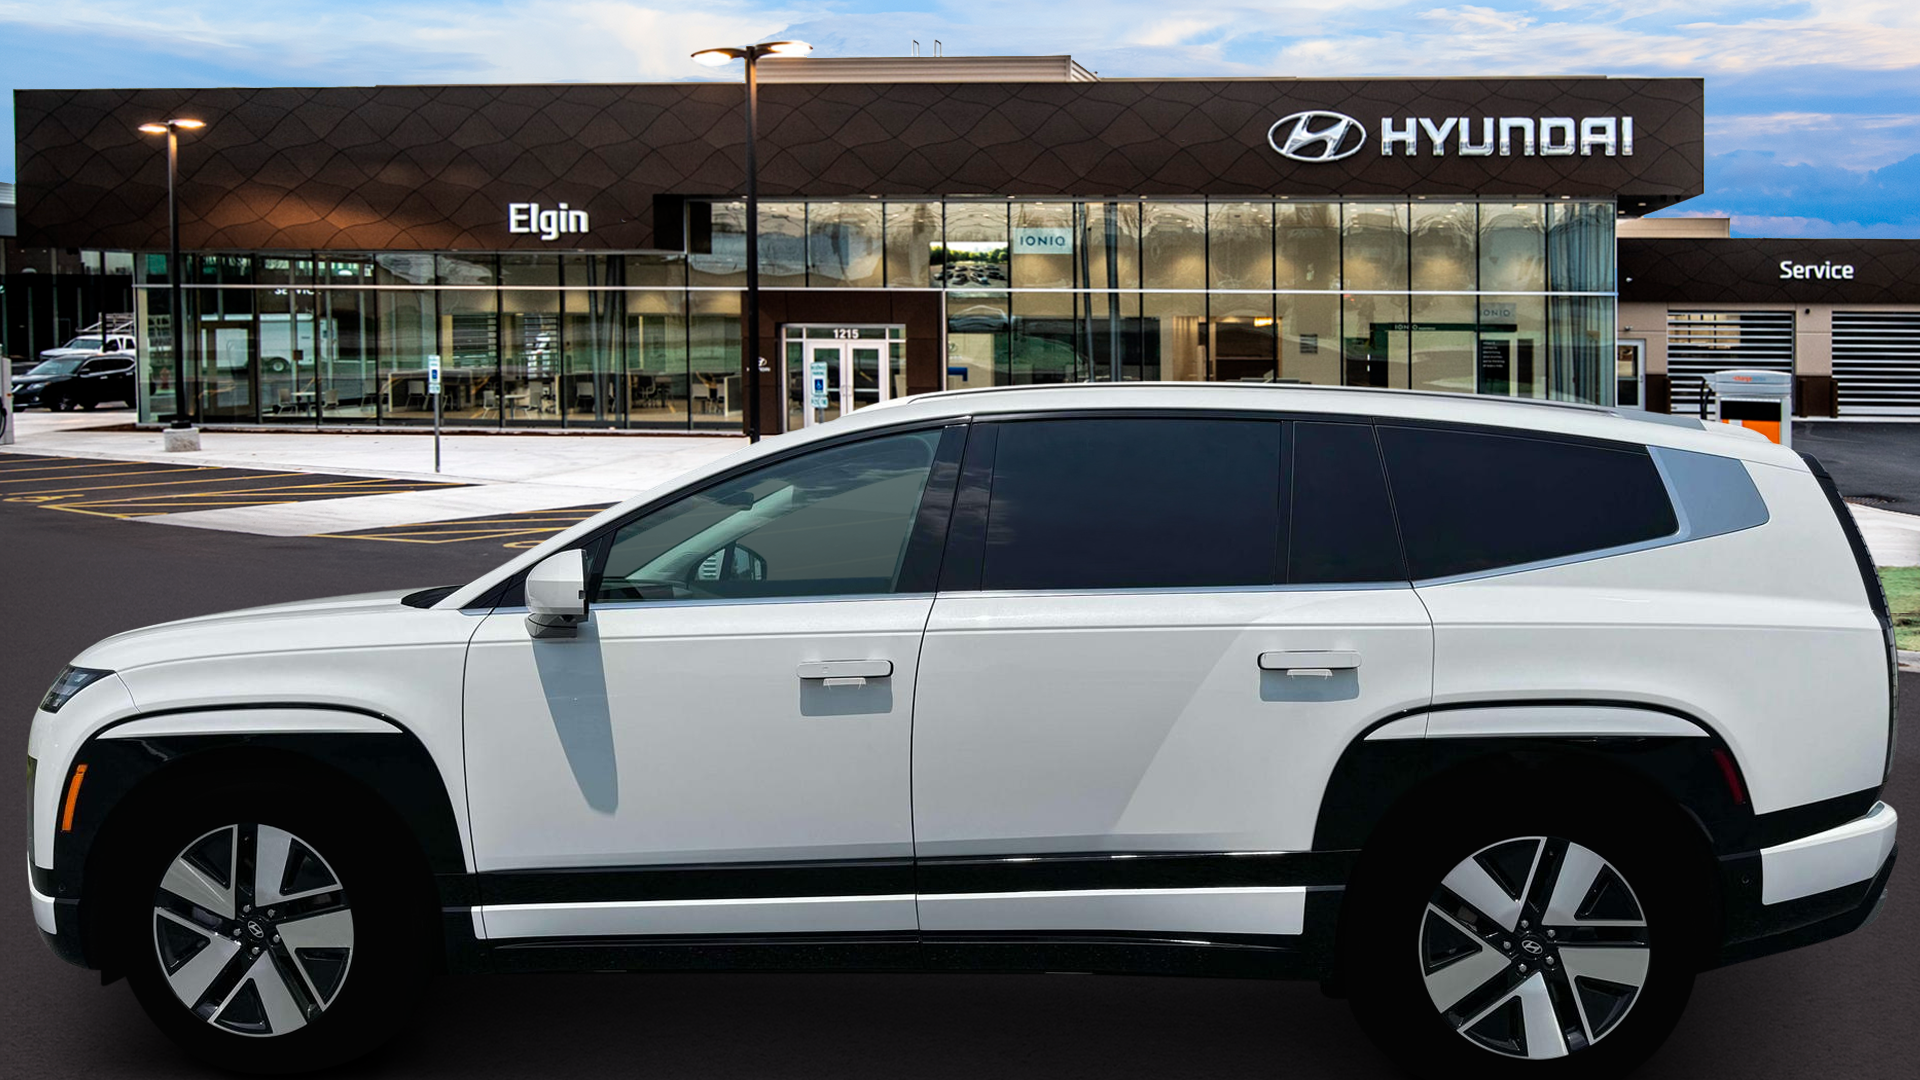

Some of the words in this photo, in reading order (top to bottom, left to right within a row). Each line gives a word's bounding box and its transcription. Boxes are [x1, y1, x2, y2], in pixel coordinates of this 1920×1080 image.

[1381, 117, 1633, 157] HYUNDAI
[508, 202, 590, 240] Elgin
[1020, 235, 1066, 246] IONIQ
[1779, 260, 1855, 280] Service
[833, 328, 859, 339] 1215
